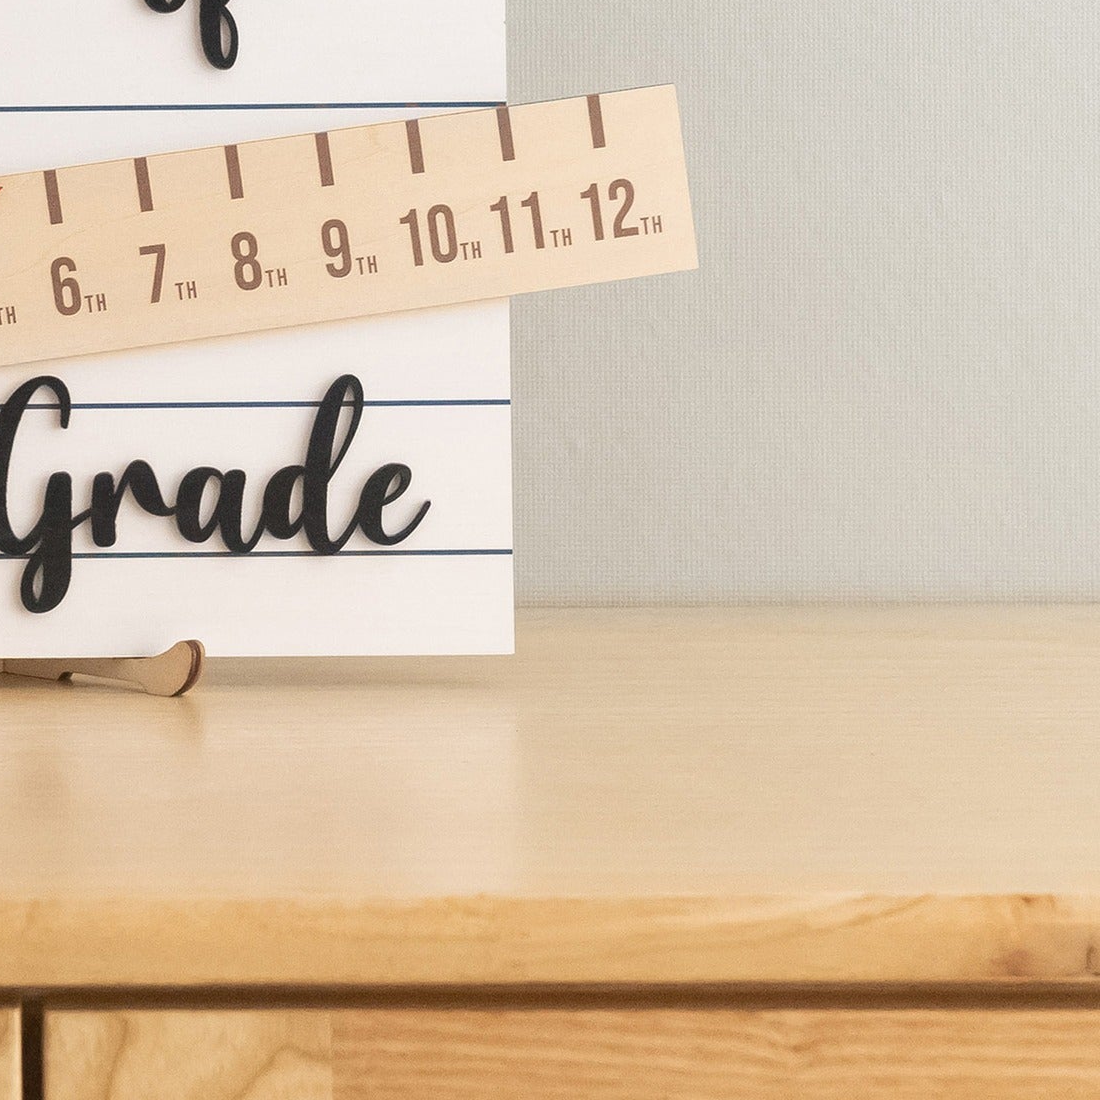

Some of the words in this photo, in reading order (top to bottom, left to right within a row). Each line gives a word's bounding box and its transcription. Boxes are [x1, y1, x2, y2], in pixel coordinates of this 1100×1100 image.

[50, 256, 108, 316] 6TH
[138, 243, 198, 303] 7TH
[230, 231, 288, 291] 8TH
[320, 218, 378, 279] 9TH
[399, 204, 482, 267] 10TH
[489, 191, 573, 254] 11TH
[580, 178, 663, 242] 12TH
